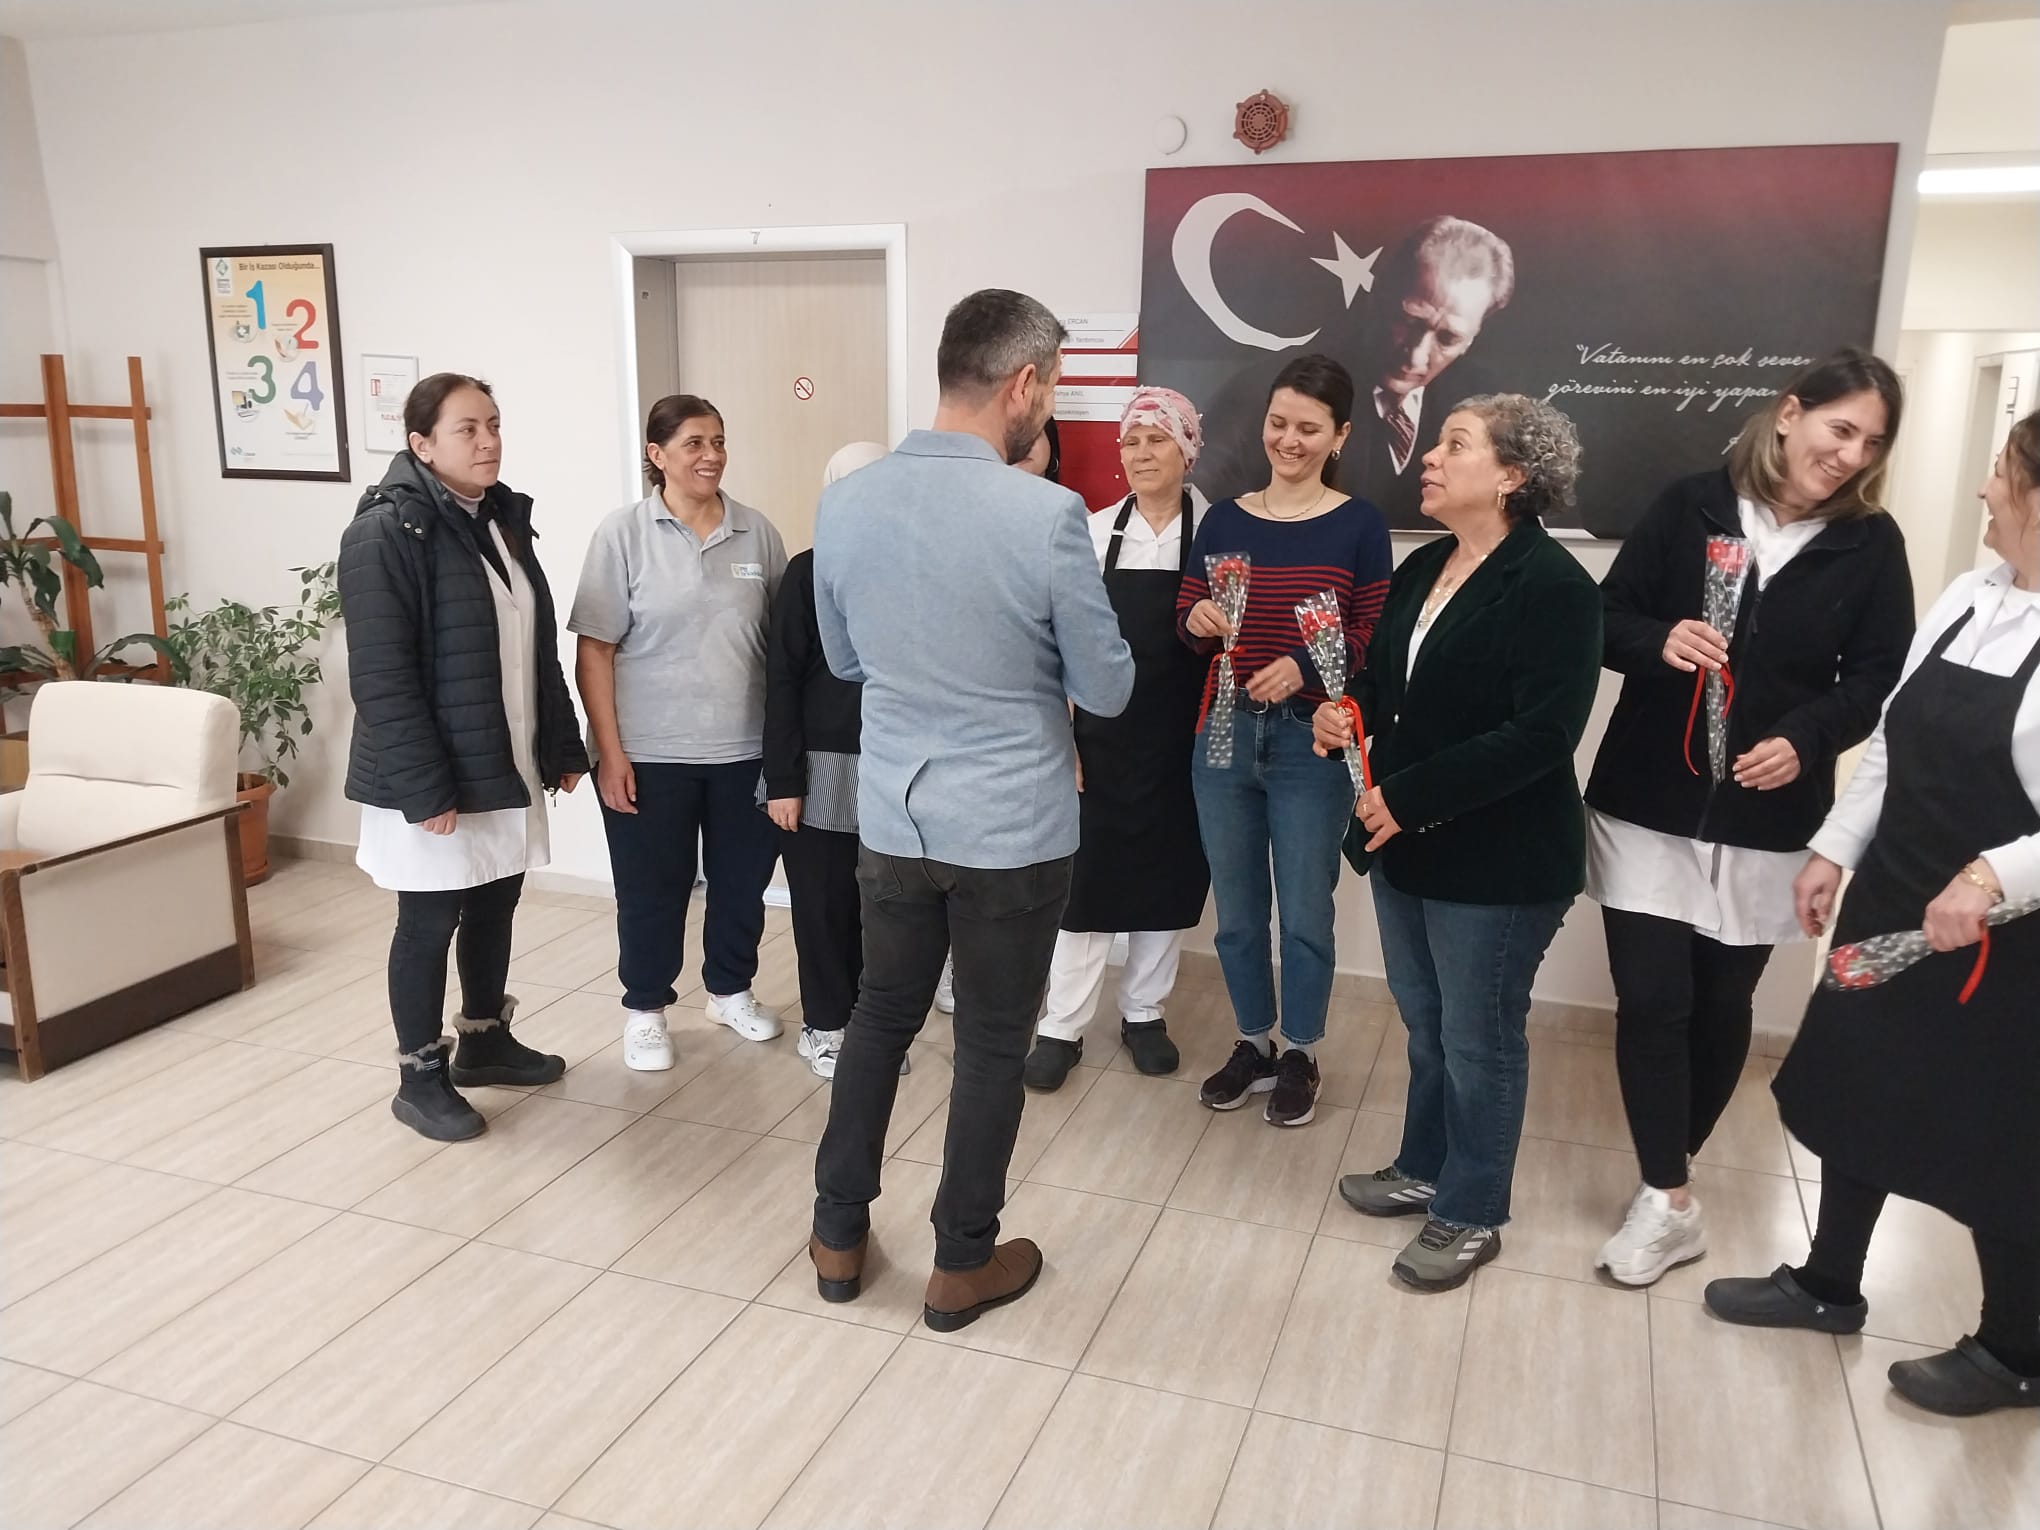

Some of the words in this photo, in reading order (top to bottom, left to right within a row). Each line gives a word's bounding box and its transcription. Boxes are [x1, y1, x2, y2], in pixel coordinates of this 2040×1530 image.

[246, 280, 266, 330] 1
[286, 298, 319, 349] 2
[247, 355, 276, 404] 3
[1679, 354, 1710, 365] en
[1712, 347, 1752, 368] çok
[290, 361, 324, 411] 4
[1539, 379, 1639, 404] görevini
[1640, 384, 1672, 396] en
[1672, 380, 1711, 412] iyi
